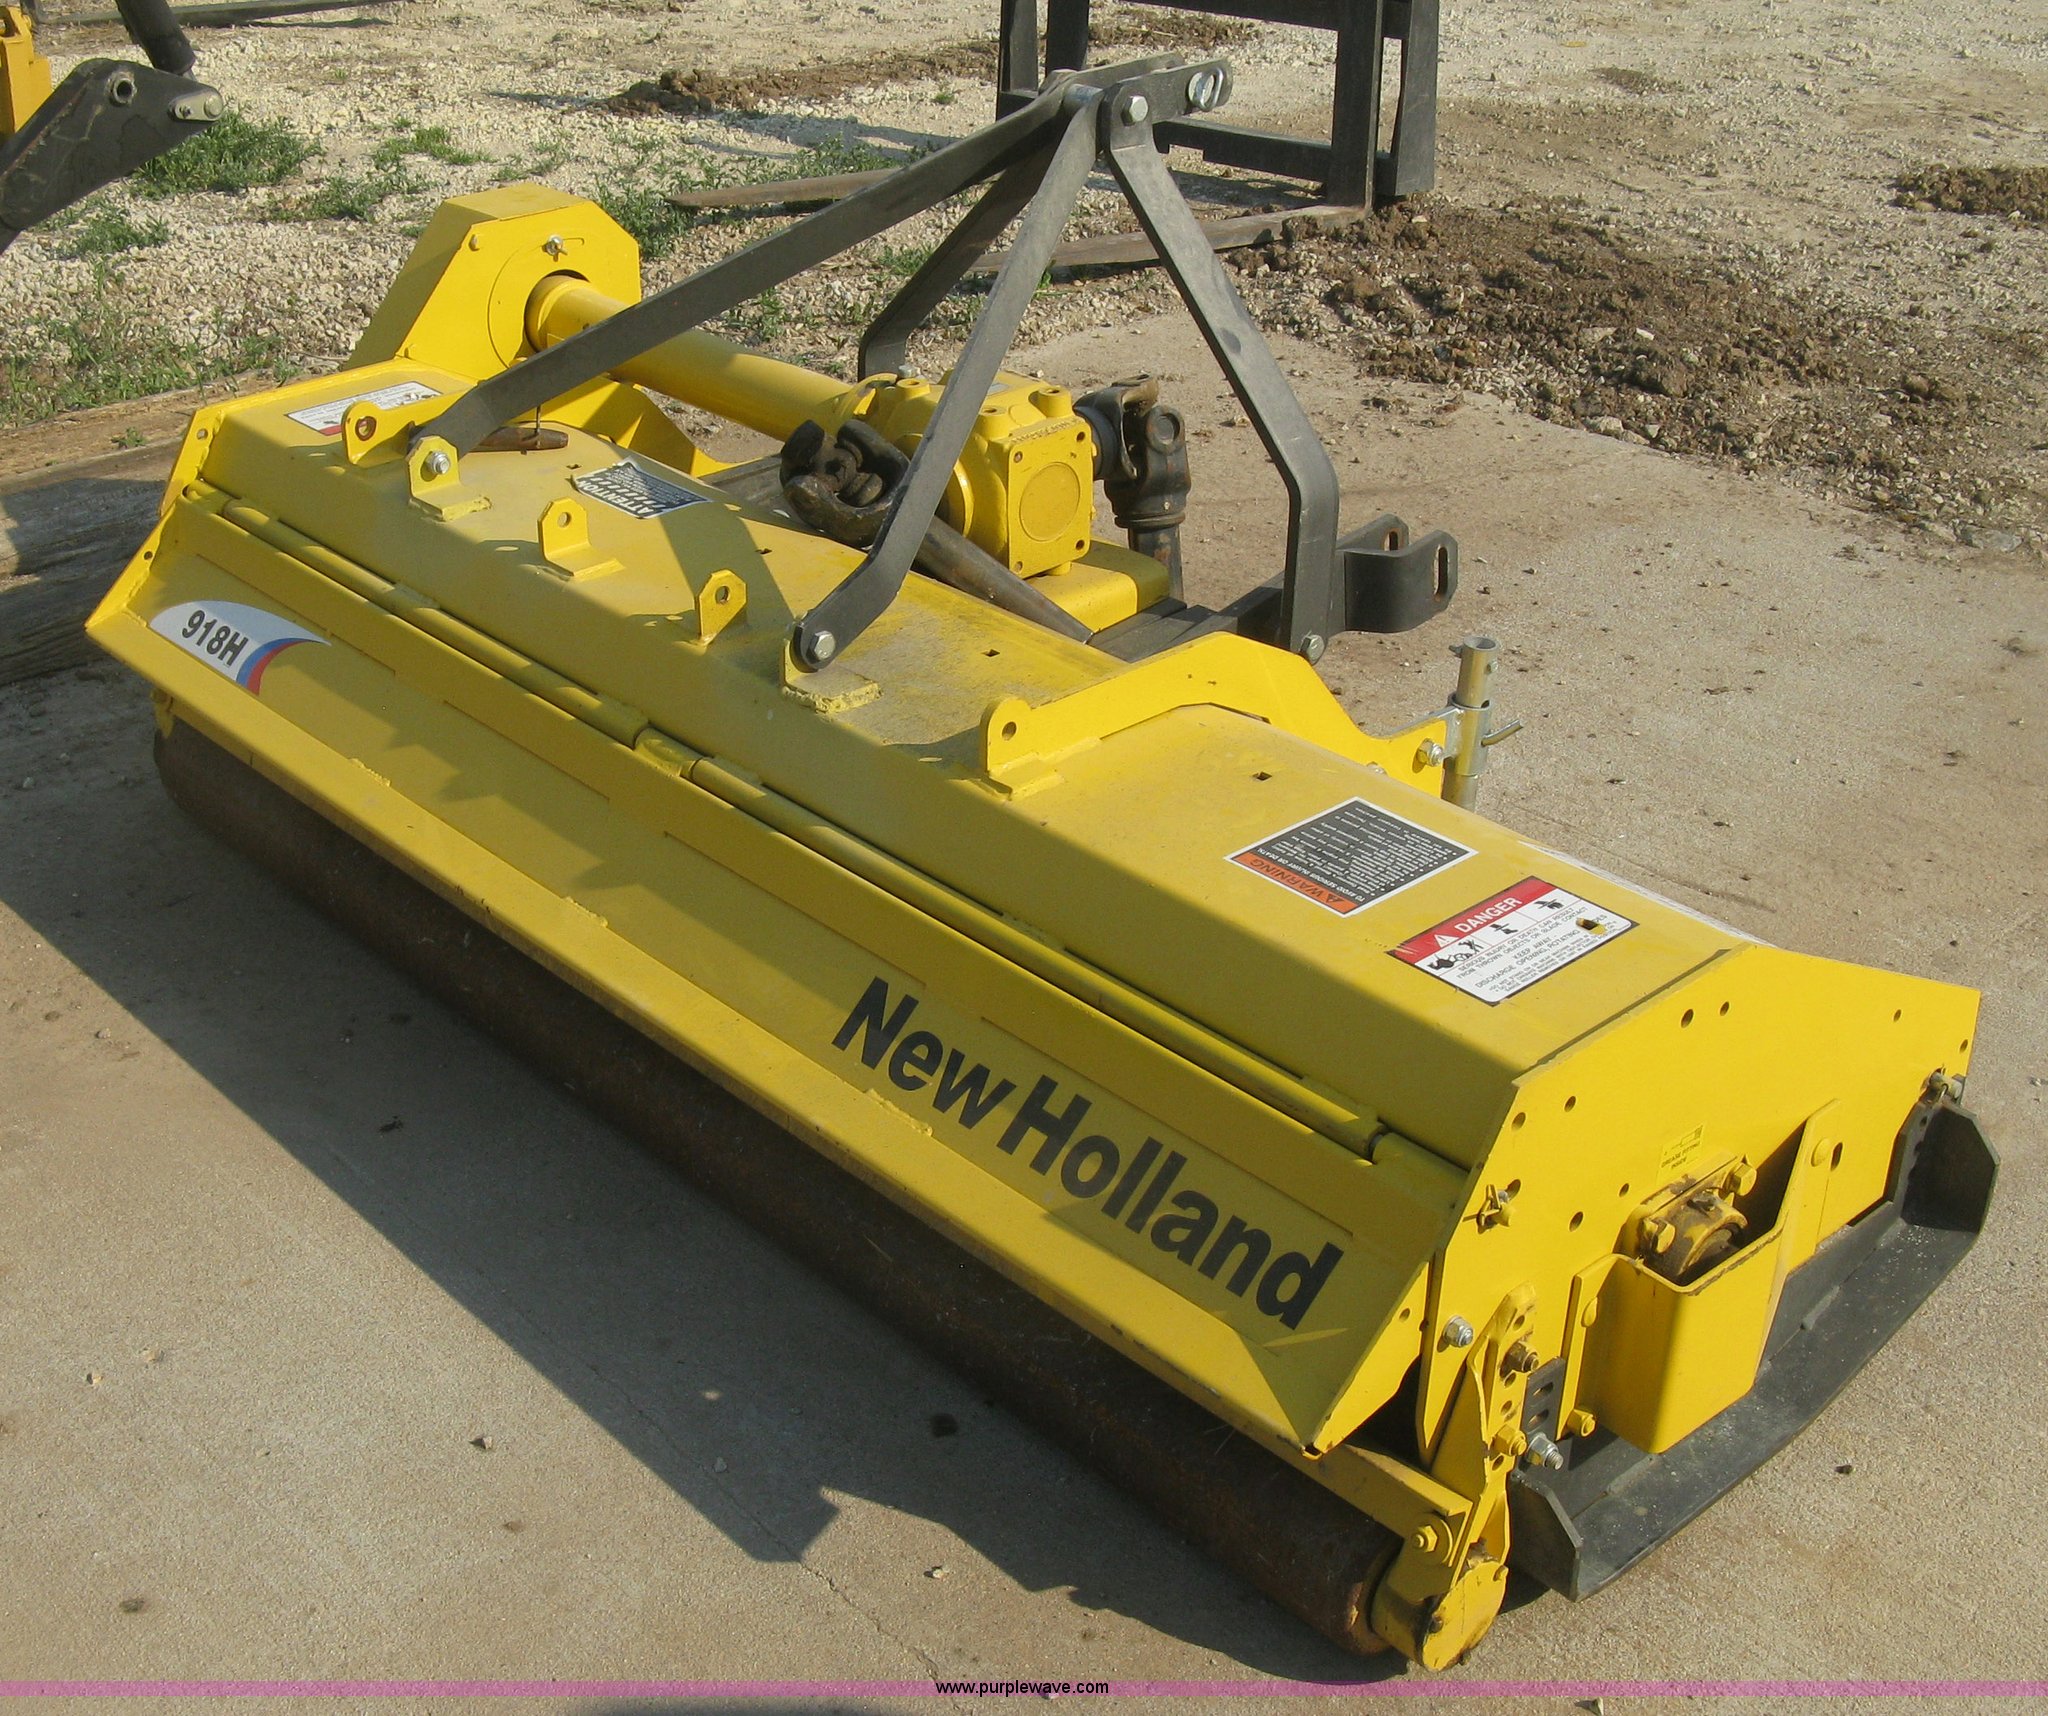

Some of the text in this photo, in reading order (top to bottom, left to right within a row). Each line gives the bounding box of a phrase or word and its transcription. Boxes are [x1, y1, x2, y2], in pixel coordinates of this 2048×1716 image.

[577, 480, 654, 515] ATTENTION
[182, 610, 249, 666] 918H
[1247, 858, 1326, 896] WARNING
[1454, 896, 1523, 933] DANGER
[832, 976, 1344, 1330] New Holland
